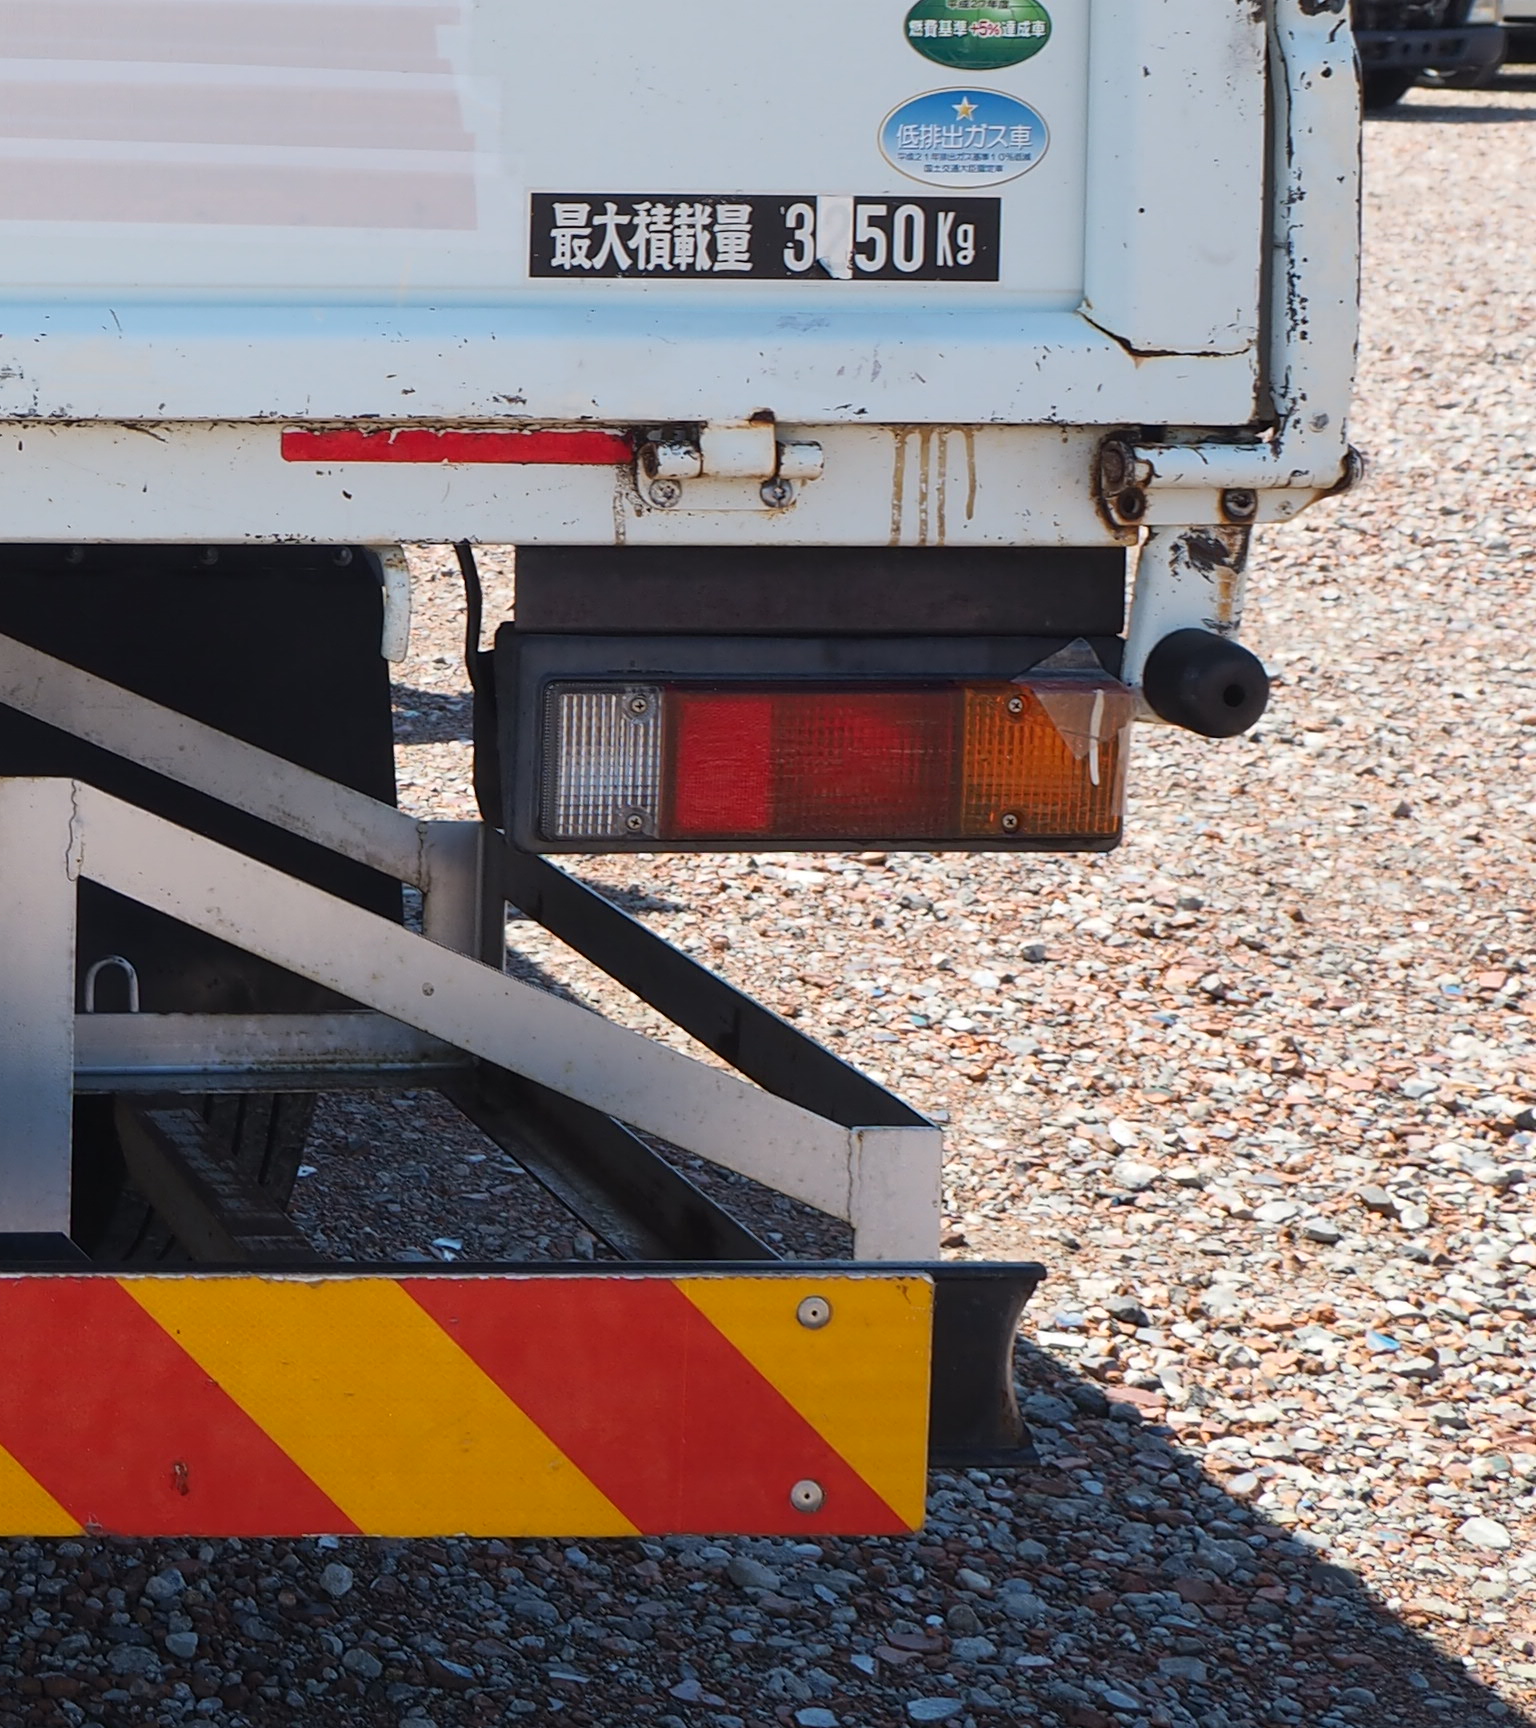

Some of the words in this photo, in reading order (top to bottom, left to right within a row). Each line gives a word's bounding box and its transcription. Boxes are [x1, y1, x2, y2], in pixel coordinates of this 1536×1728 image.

[896, 123, 1033, 150] 低排出ガス車
[549, 201, 753, 272] 最大積載量
